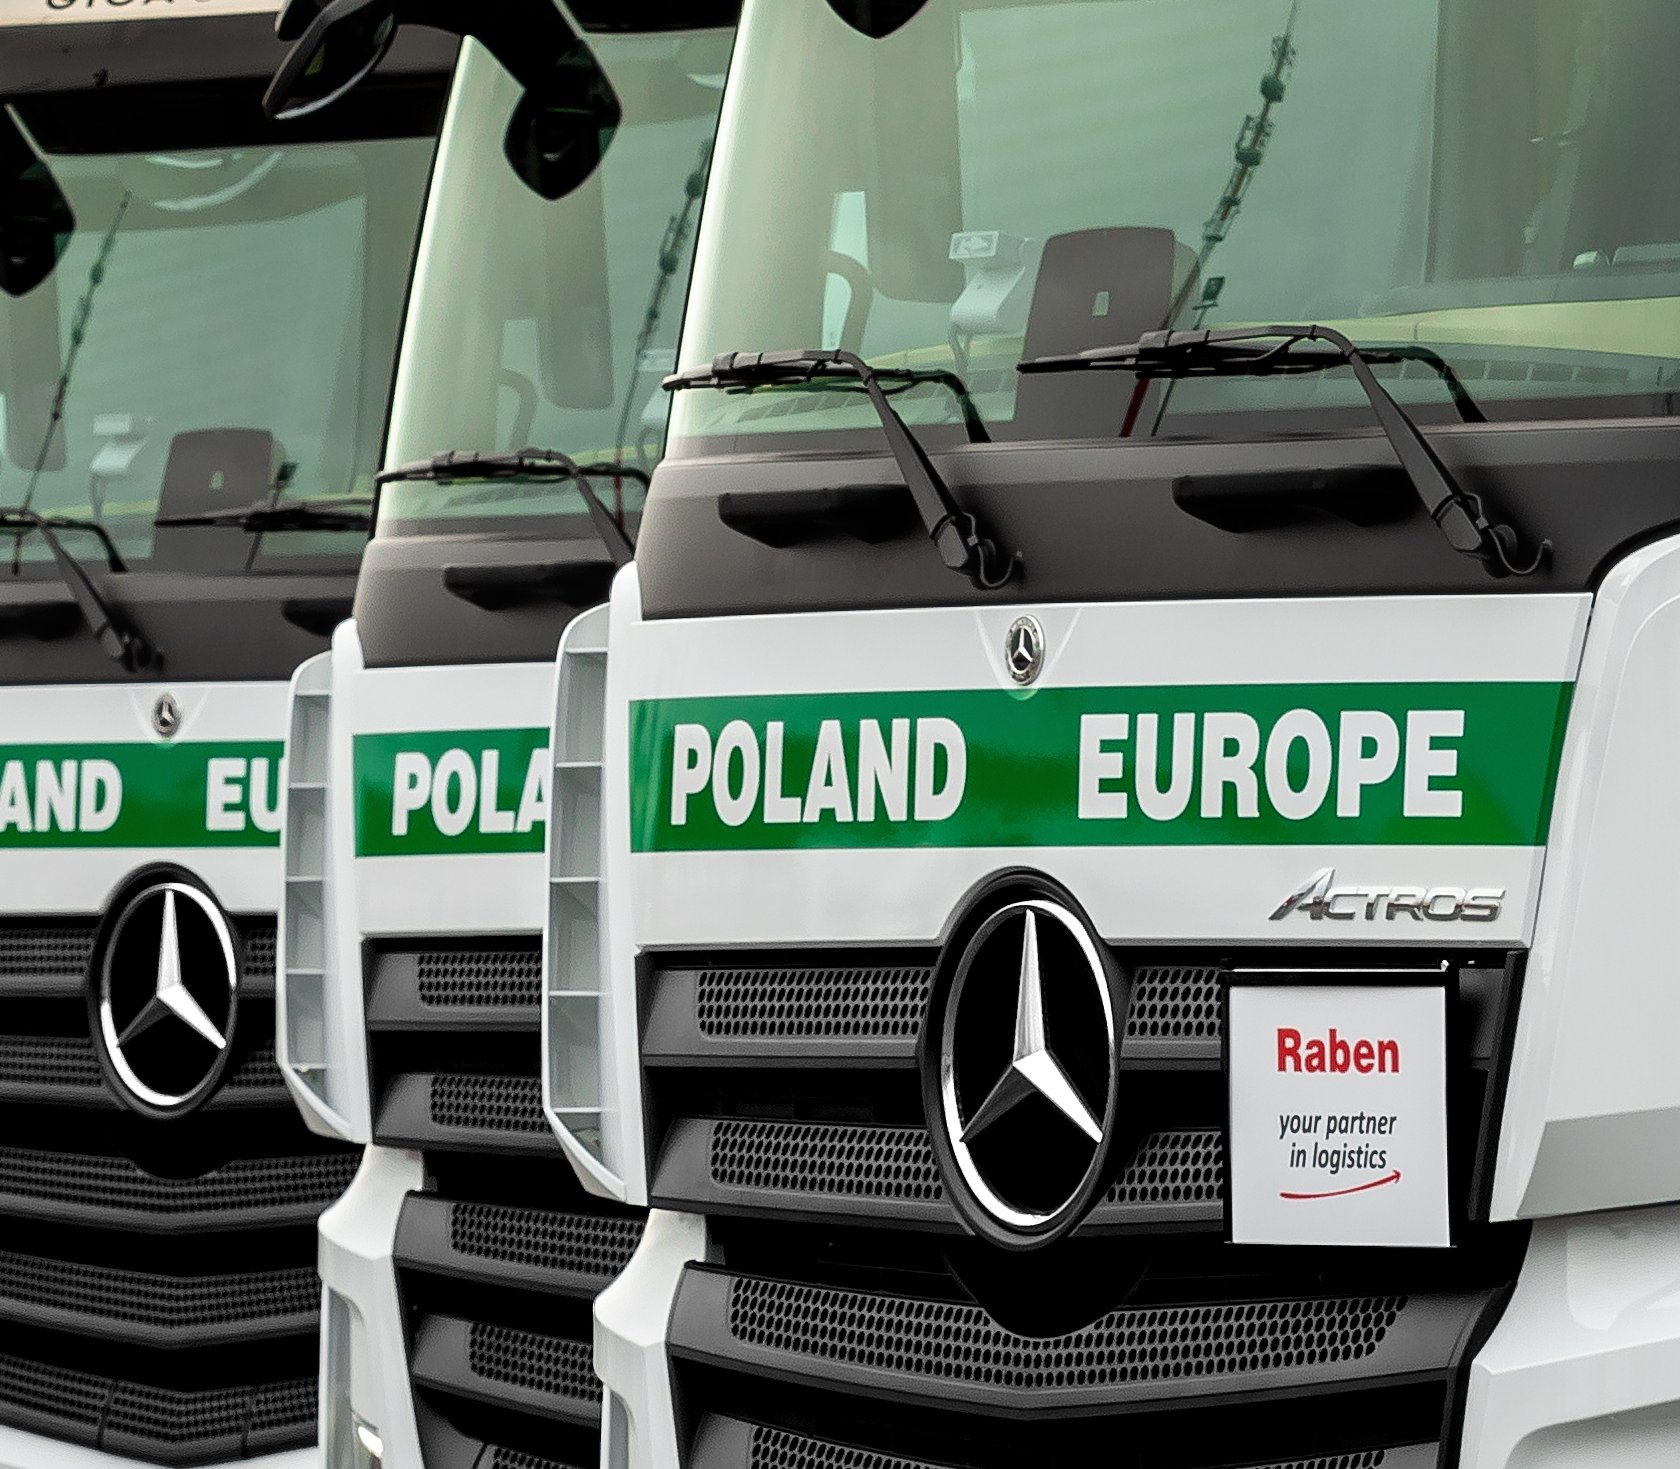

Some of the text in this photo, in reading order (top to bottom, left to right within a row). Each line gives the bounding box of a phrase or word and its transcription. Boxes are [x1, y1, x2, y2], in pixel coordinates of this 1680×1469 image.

[670, 708, 1466, 827] POLAND EUROPE
[391, 747, 550, 837] POLA
[1276, 1028, 1401, 1073] Raben
[1279, 1111, 1397, 1140] your partner
[1289, 1141, 1388, 1175] in logistics
